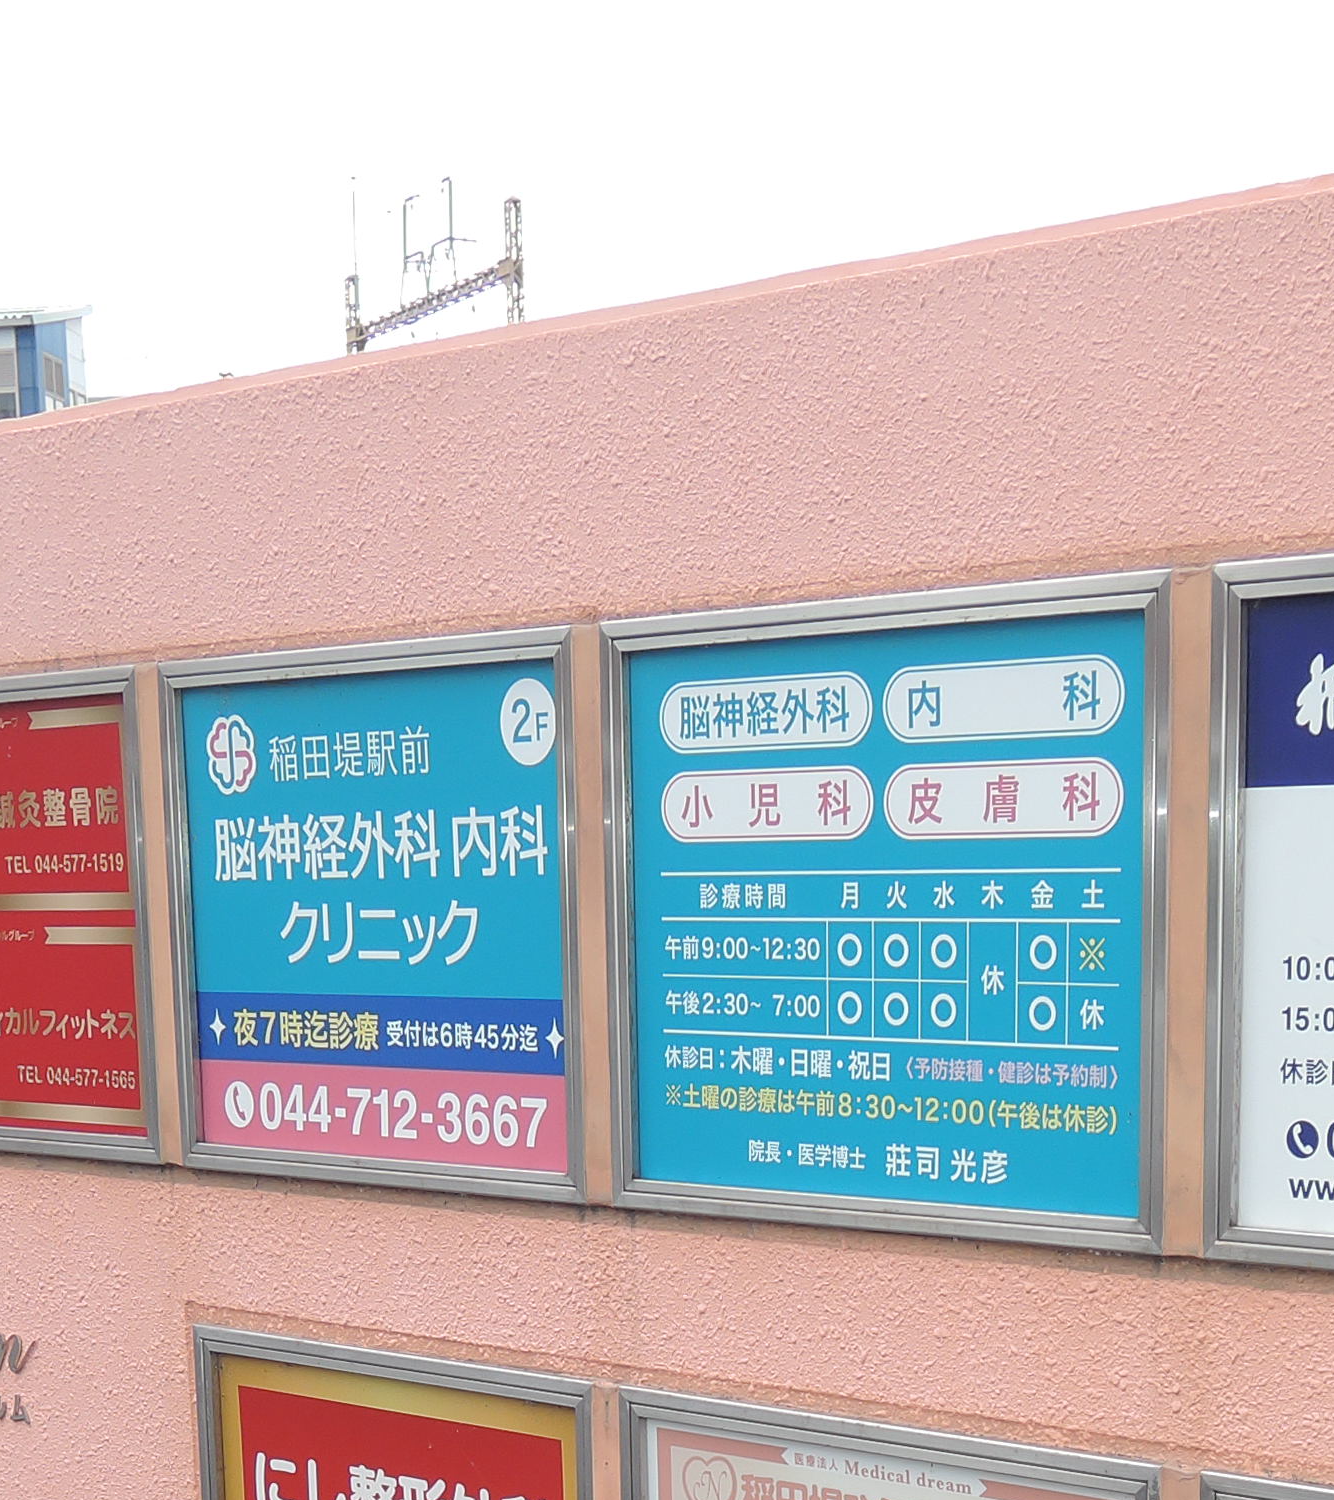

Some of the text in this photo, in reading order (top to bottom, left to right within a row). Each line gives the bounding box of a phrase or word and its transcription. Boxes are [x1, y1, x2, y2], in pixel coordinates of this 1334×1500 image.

[511, 698, 549, 742] 2F
[679, 686, 850, 739] 脳神経外科
[907, 671, 1101, 728] 内科
[269, 726, 430, 782] 稲田堤駅前
[681, 779, 851, 828] 小児科
[908, 772, 1101, 825] 皮膚科
[5, 853, 124, 874] TEL 044-577-1519
[215, 804, 548, 881] 脳神経外科 内科
[700, 881, 1105, 910] 診療時間 月 火 水 木 金 土
[280, 899, 479, 965] クリニック
[981, 965, 1005, 996] 休
[233, 1009, 539, 1052] 夜7時迄診療 受付は6時45分迄
[1080, 999, 1105, 1030] 休
[17, 1065, 136, 1089] TEL 044-577-1565
[259, 1081, 548, 1148] 044-712-3667
[747, 1138, 867, 1170] 院長・医学博士
[950, 1148, 1009, 1184] 光彦
[794, 1452, 972, 1495] 医療法人 Medical dream
